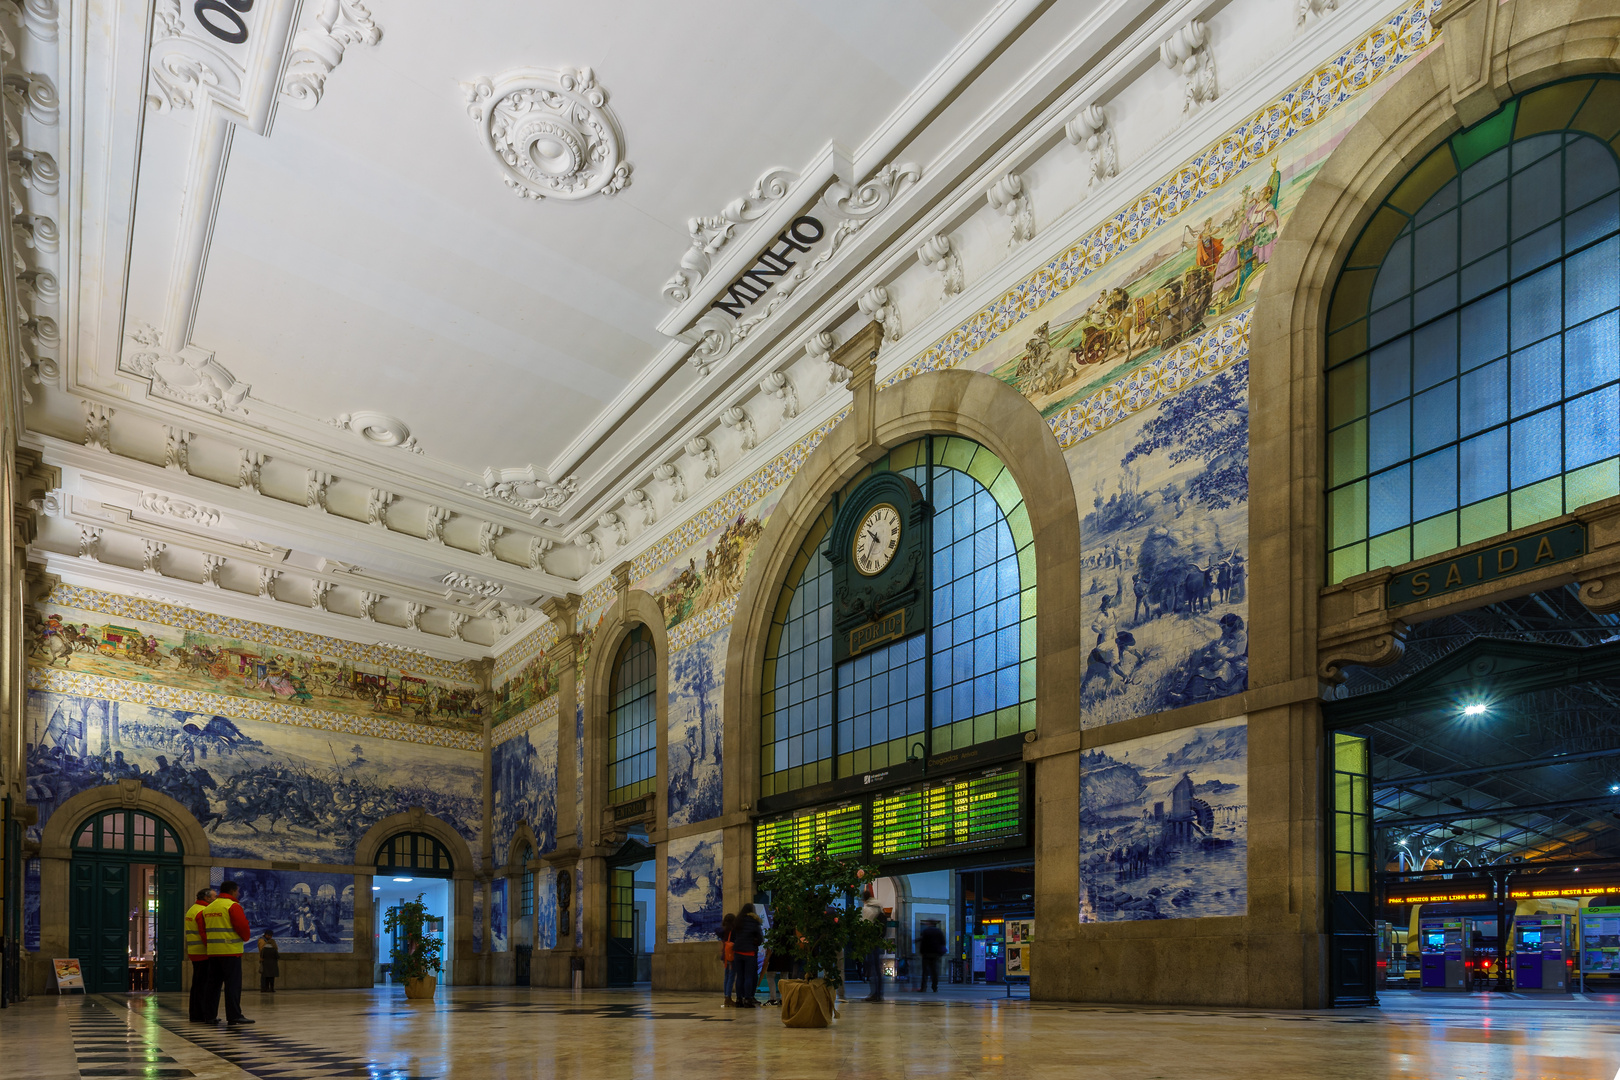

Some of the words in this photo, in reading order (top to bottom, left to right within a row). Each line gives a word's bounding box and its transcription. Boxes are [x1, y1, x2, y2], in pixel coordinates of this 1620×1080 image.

[711, 215, 824, 320] MINHO
[1411, 536, 1556, 596] SAIDA
[858, 616, 896, 645] PORTO
[928, 754, 958, 768] Chegadas
